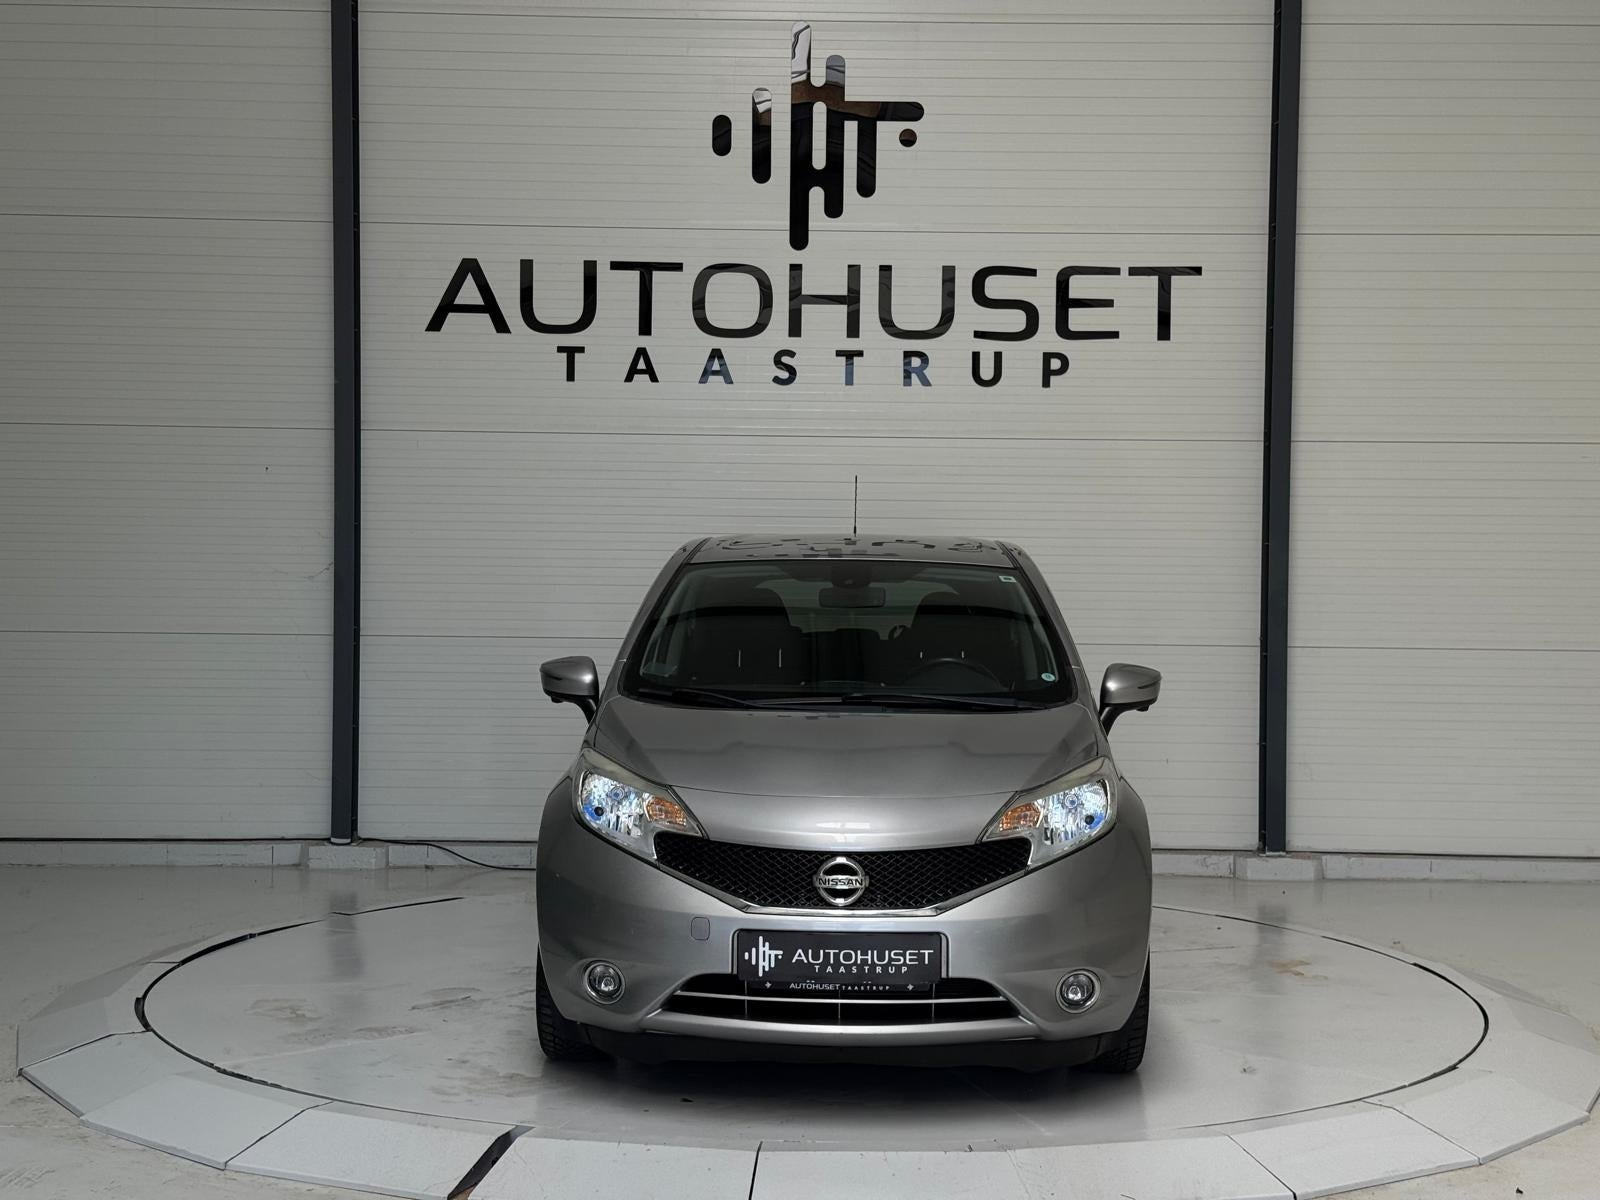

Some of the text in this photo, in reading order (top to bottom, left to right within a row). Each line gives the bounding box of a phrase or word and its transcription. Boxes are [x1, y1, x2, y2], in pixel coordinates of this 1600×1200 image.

[424, 257, 1203, 341] AUTOHUSET
[556, 345, 1070, 388] TAASTRUP
[818, 878, 863, 886] NISSAN
[791, 948, 934, 965] AUTOHUSET
[814, 965, 908, 974] TAASTRUP
[789, 982, 840, 991] AUTOHUSET
